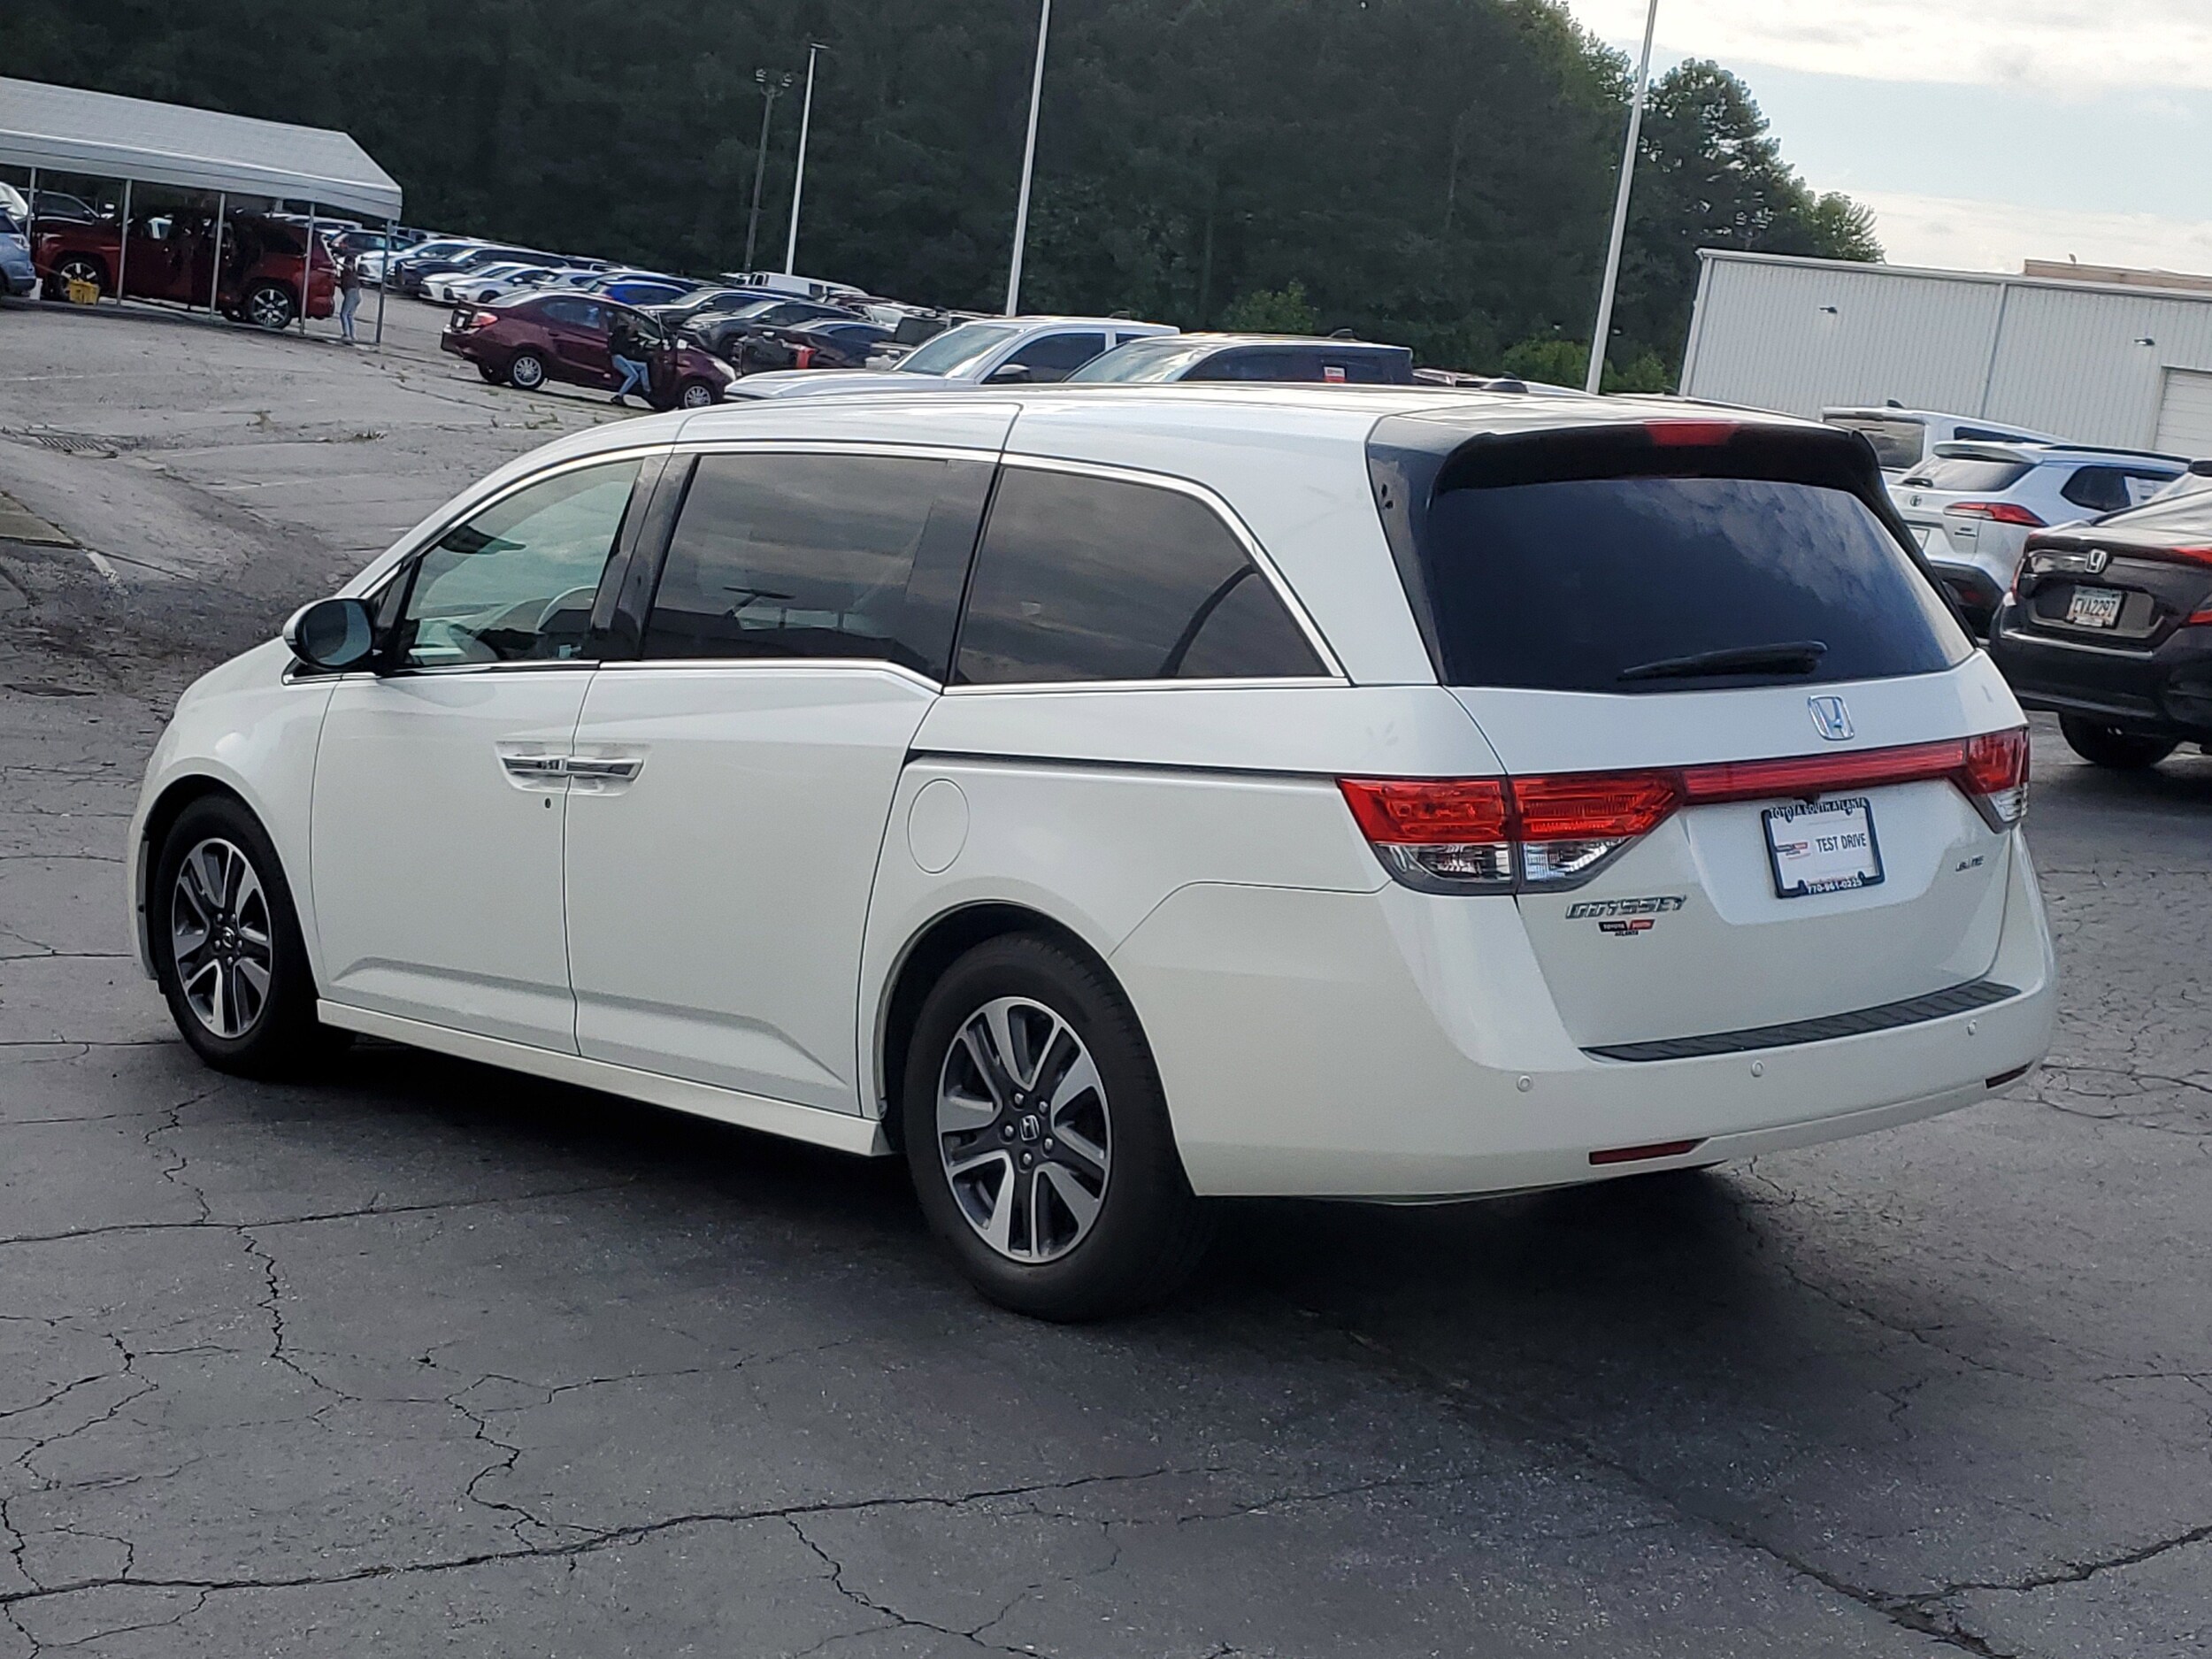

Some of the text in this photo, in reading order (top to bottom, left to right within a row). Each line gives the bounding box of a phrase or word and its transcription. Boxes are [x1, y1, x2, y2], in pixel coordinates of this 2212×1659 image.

[1770, 803, 1803, 819] TOYOTA
[1816, 836, 1839, 853] TEST
[1840, 833, 1867, 849] DRIVE
[1565, 893, 1687, 919] ODYSSEY
